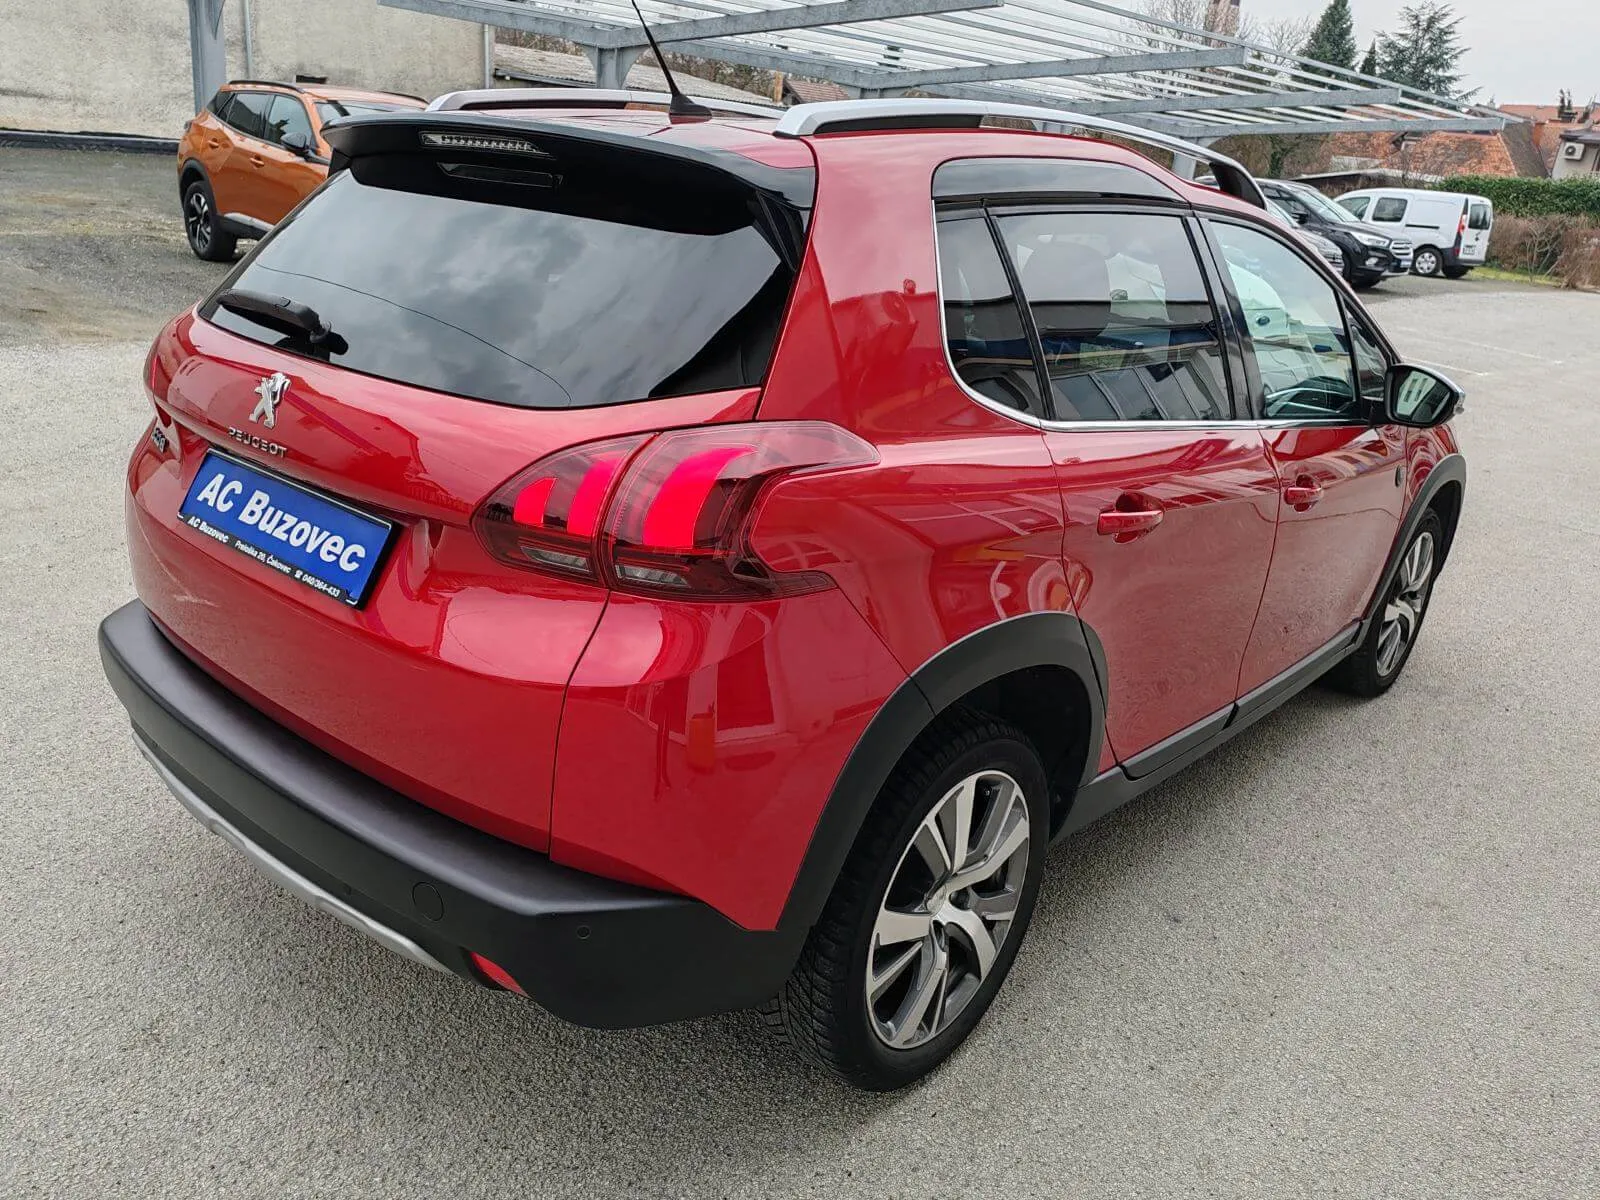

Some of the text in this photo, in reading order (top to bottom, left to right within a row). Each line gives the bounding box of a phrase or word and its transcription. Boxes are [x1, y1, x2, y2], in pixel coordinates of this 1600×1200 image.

[228, 427, 288, 458] PEUGEOT
[187, 516, 201, 528] AC
[199, 521, 229, 543] Buzovec
[198, 473, 366, 572] AC Buzovec
